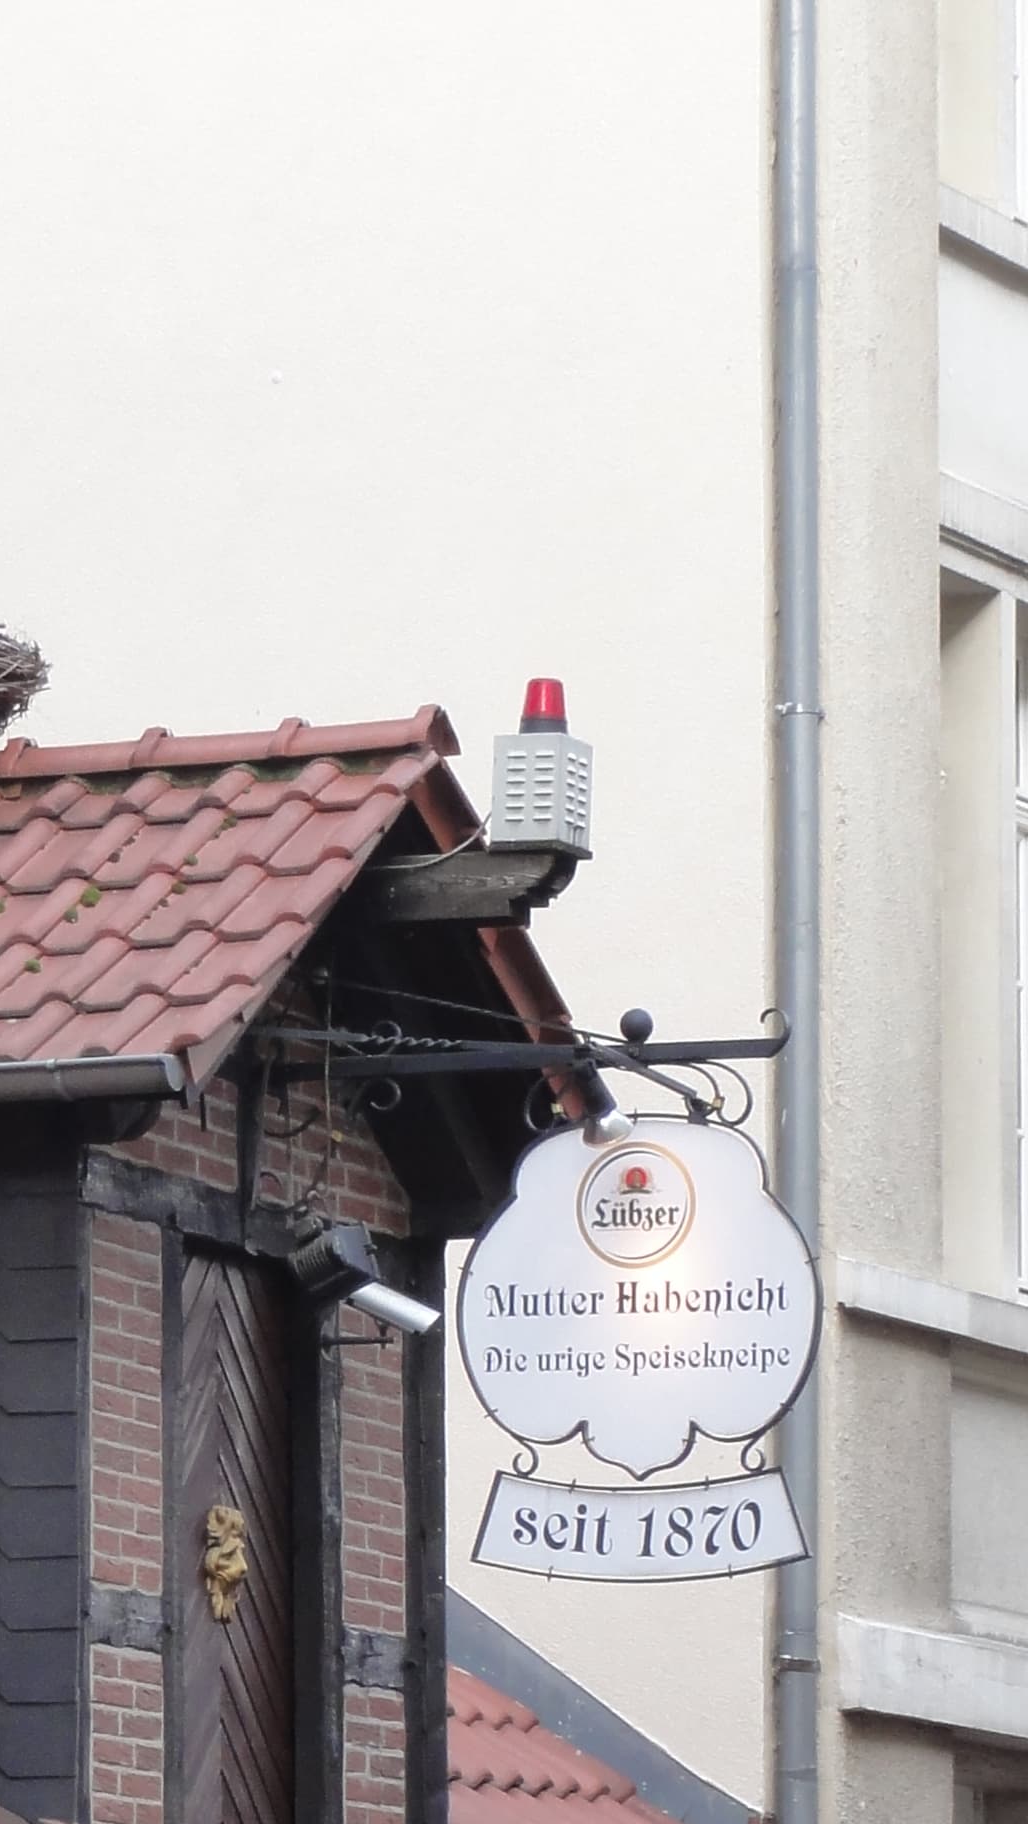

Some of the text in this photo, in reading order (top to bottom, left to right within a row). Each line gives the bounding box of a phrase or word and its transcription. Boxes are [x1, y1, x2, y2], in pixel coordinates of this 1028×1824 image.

[590, 1201, 680, 1231] Lübzer
[484, 1277, 790, 1318] Mutter Habenicht
[483, 1342, 791, 1378] Die urige Speisekneipe
[512, 1498, 762, 1559] seit 1870
